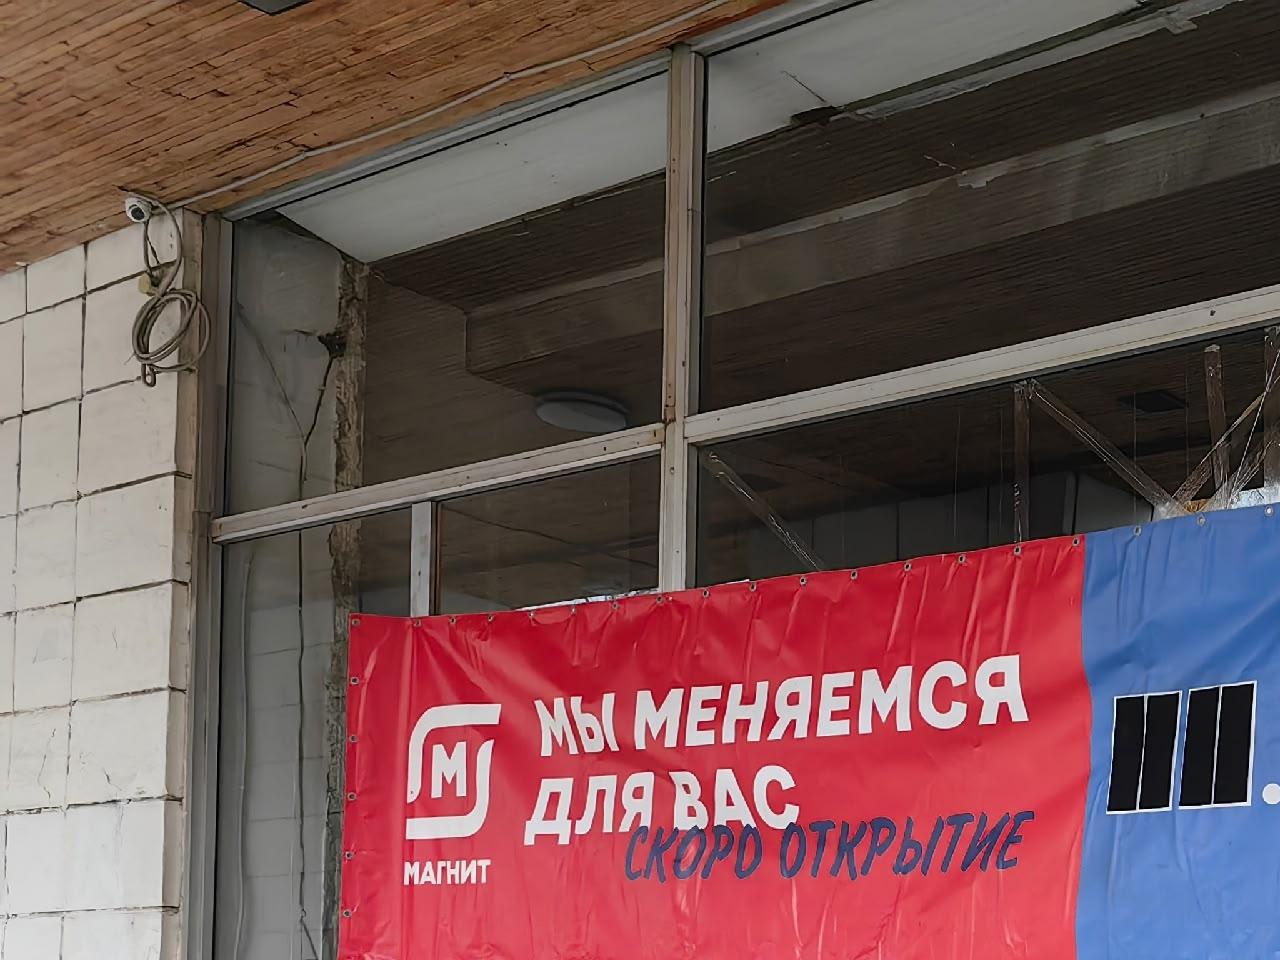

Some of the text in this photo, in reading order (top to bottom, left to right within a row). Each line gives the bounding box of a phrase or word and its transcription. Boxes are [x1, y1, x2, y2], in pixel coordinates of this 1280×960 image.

[534, 654, 1029, 759] МЫ МЕНЯЕМСЯ
[523, 765, 800, 846] ДЛЯ ВАС
[403, 858, 492, 886] МАГНИТ
[625, 810, 1035, 883] СКОРО ОТКРЫТИЕ
